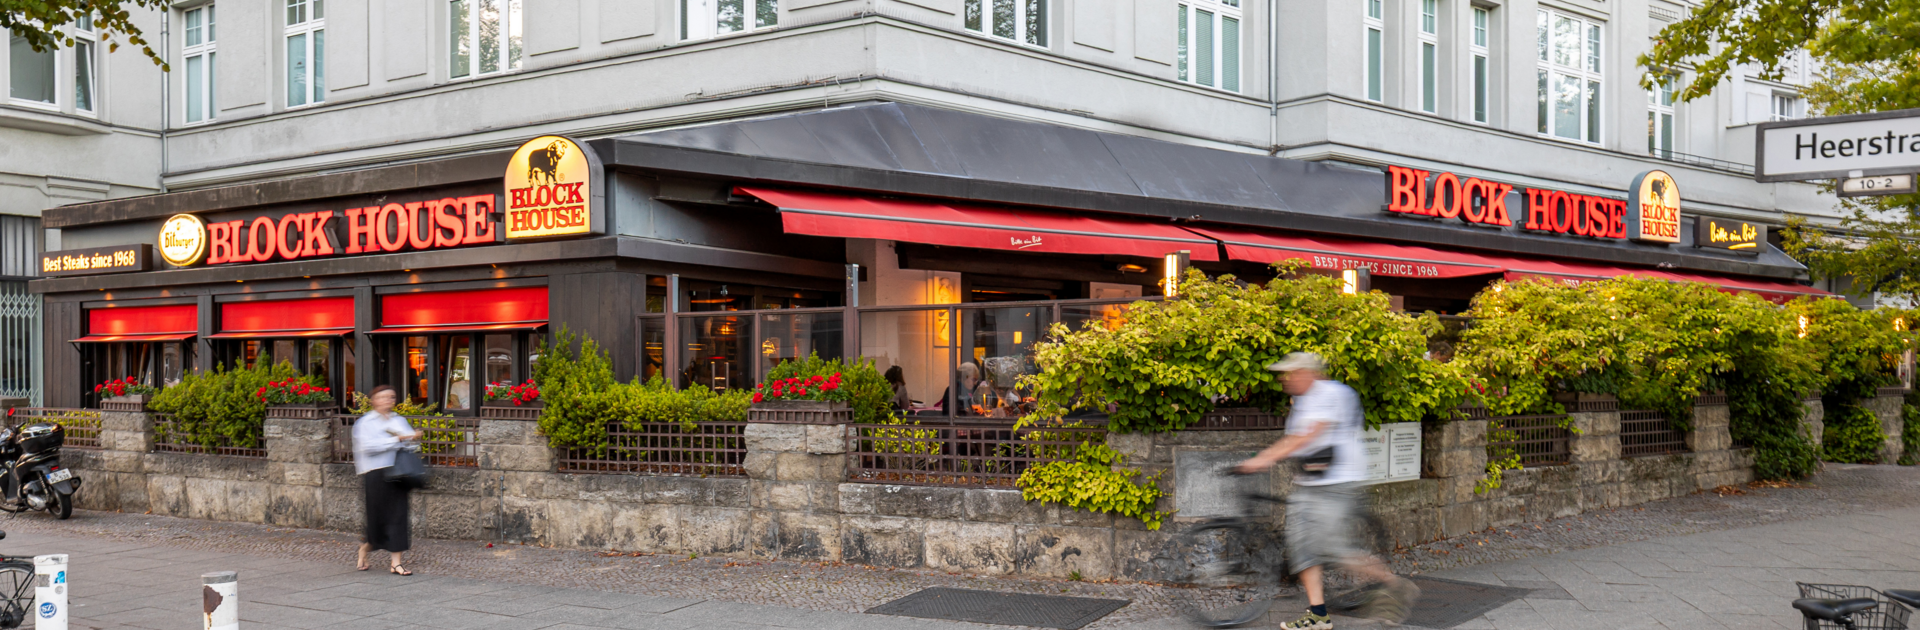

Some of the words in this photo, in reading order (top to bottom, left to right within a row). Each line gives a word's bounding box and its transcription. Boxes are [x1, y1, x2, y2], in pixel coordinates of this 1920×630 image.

[510, 182, 584, 209] BLOCK
[1388, 165, 1514, 227] BLOCK
[1525, 187, 1627, 239] HOUSE
[510, 205, 585, 232] HOUSE
[1641, 203, 1678, 222] BLOCK
[165, 231, 194, 249] Bitburger
[207, 210, 334, 265] BLOCK
[345, 193, 496, 254] HOUSE
[1642, 220, 1678, 238] HOUSE
[1710, 221, 1728, 243] Bitte
[1729, 230, 1742, 242] ein
[1742, 222, 1758, 243] Bit
[43, 256, 61, 272] Best
[63, 253, 90, 270] Steaks
[91, 252, 112, 268] since
[113, 250, 135, 267] 1968
[1313, 255, 1338, 269] BEST
[1382, 262, 1413, 275] SINCE
[1416, 265, 1439, 277] 1968
